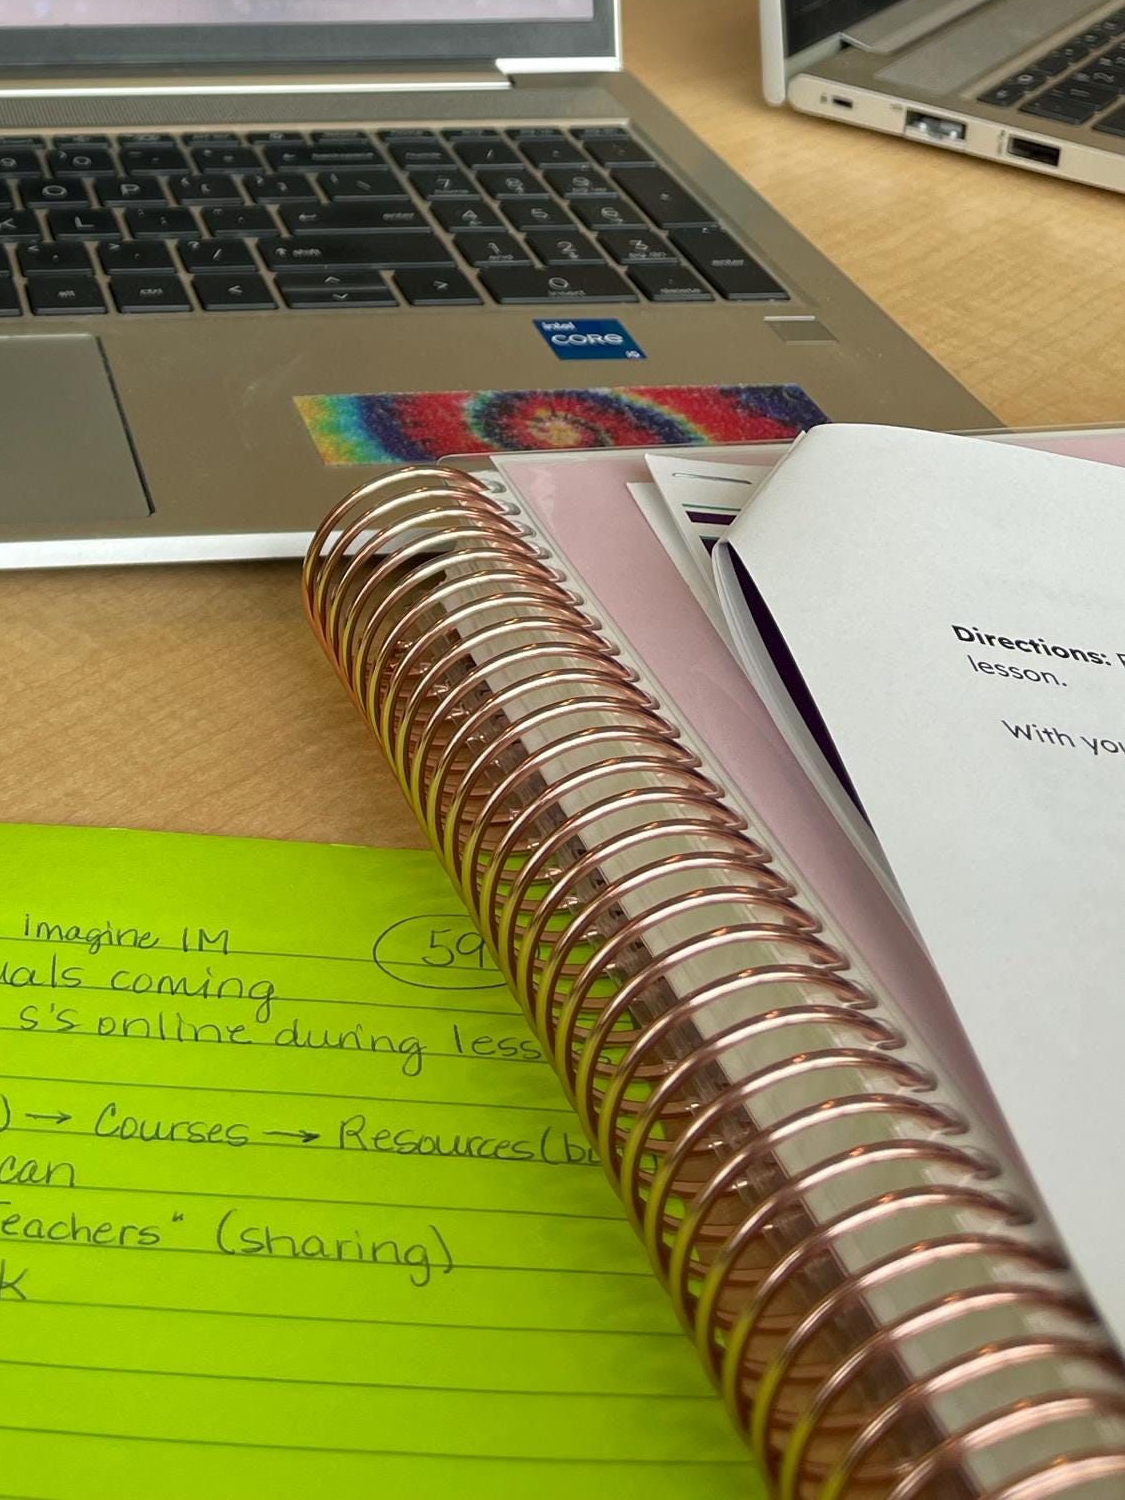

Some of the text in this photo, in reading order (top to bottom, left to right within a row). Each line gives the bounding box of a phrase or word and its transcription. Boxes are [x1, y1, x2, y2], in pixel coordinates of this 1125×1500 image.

[121, 184, 140, 196] P
[75, 216, 95, 228] L
[952, 624, 1112, 666] Directions:
[968, 654, 1068, 687] lesson.
[1002, 719, 1076, 748] With
[110, 966, 277, 1023] coming
[98, 1011, 253, 1044] online
[275, 1018, 427, 1077] during
[453, 1024, 543, 1060] less
[95, 1102, 250, 1147] Courses
[217, 1207, 453, 1288] (sharing)
